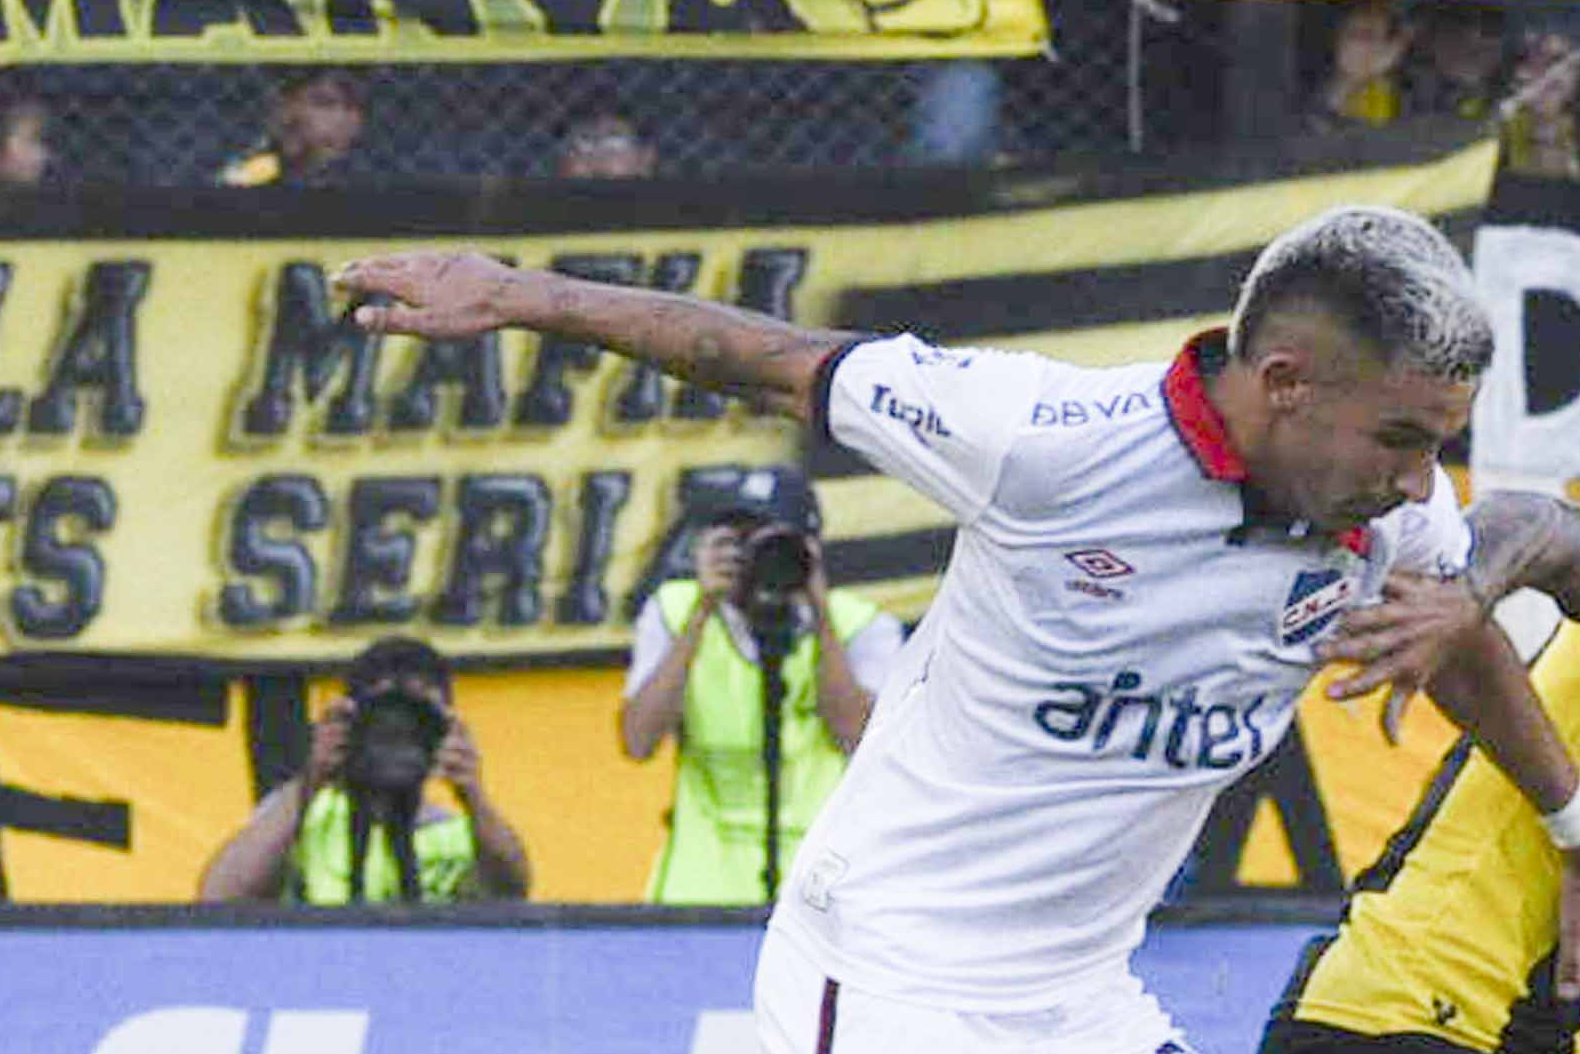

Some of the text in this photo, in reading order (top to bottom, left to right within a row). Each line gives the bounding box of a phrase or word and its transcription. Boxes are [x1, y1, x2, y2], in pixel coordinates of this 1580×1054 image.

[0, 259, 152, 436] A
[0, 467, 742, 640] S SERI
[1033, 670, 1265, 769] antel
